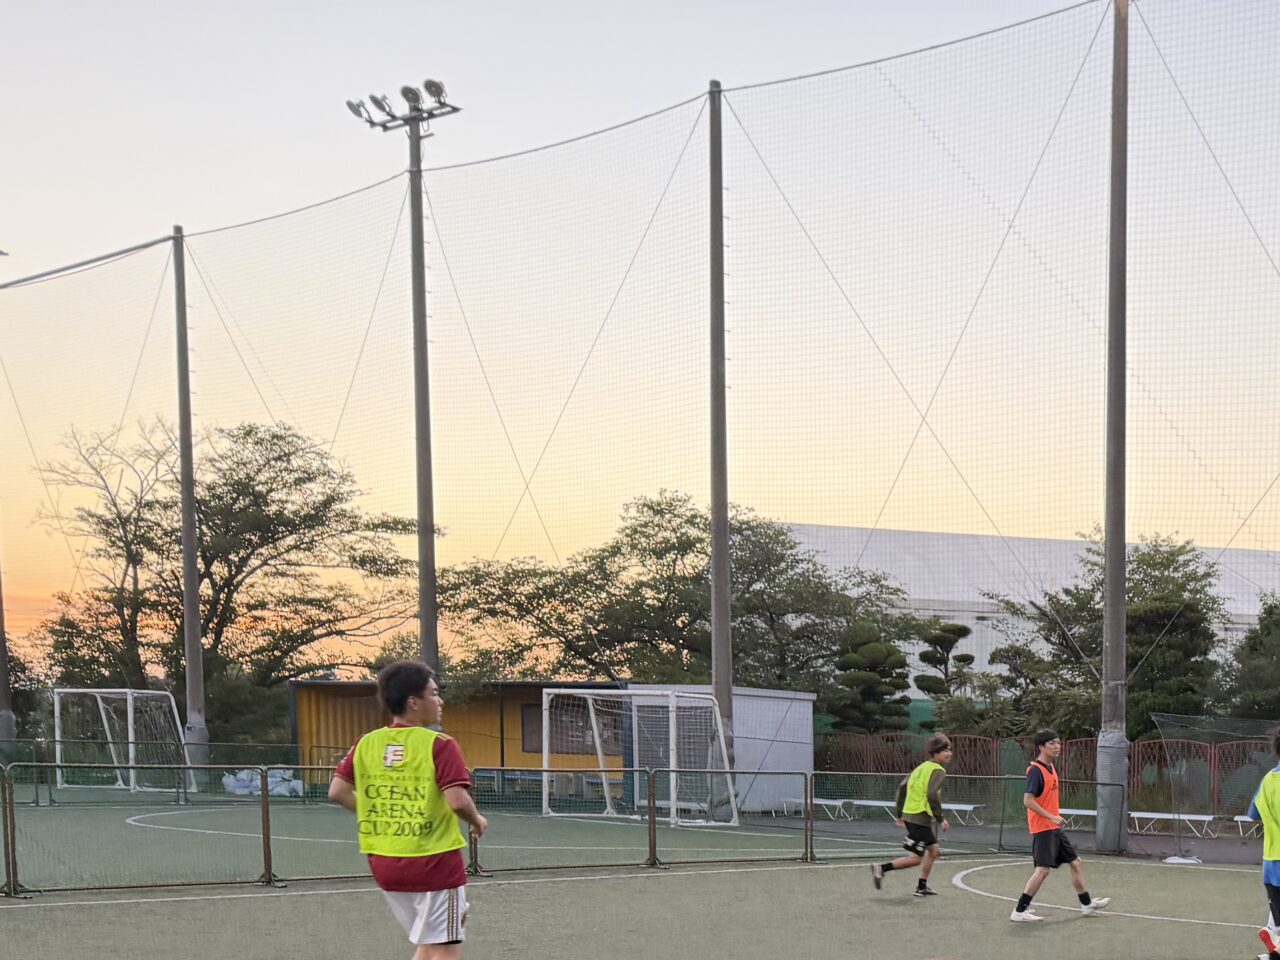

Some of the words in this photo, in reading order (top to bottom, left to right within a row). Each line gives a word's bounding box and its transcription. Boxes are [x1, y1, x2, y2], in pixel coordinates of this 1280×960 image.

[365, 784, 426, 801] OCEAN
[366, 803, 426, 819] ARENA
[393, 821, 433, 837] 2009
